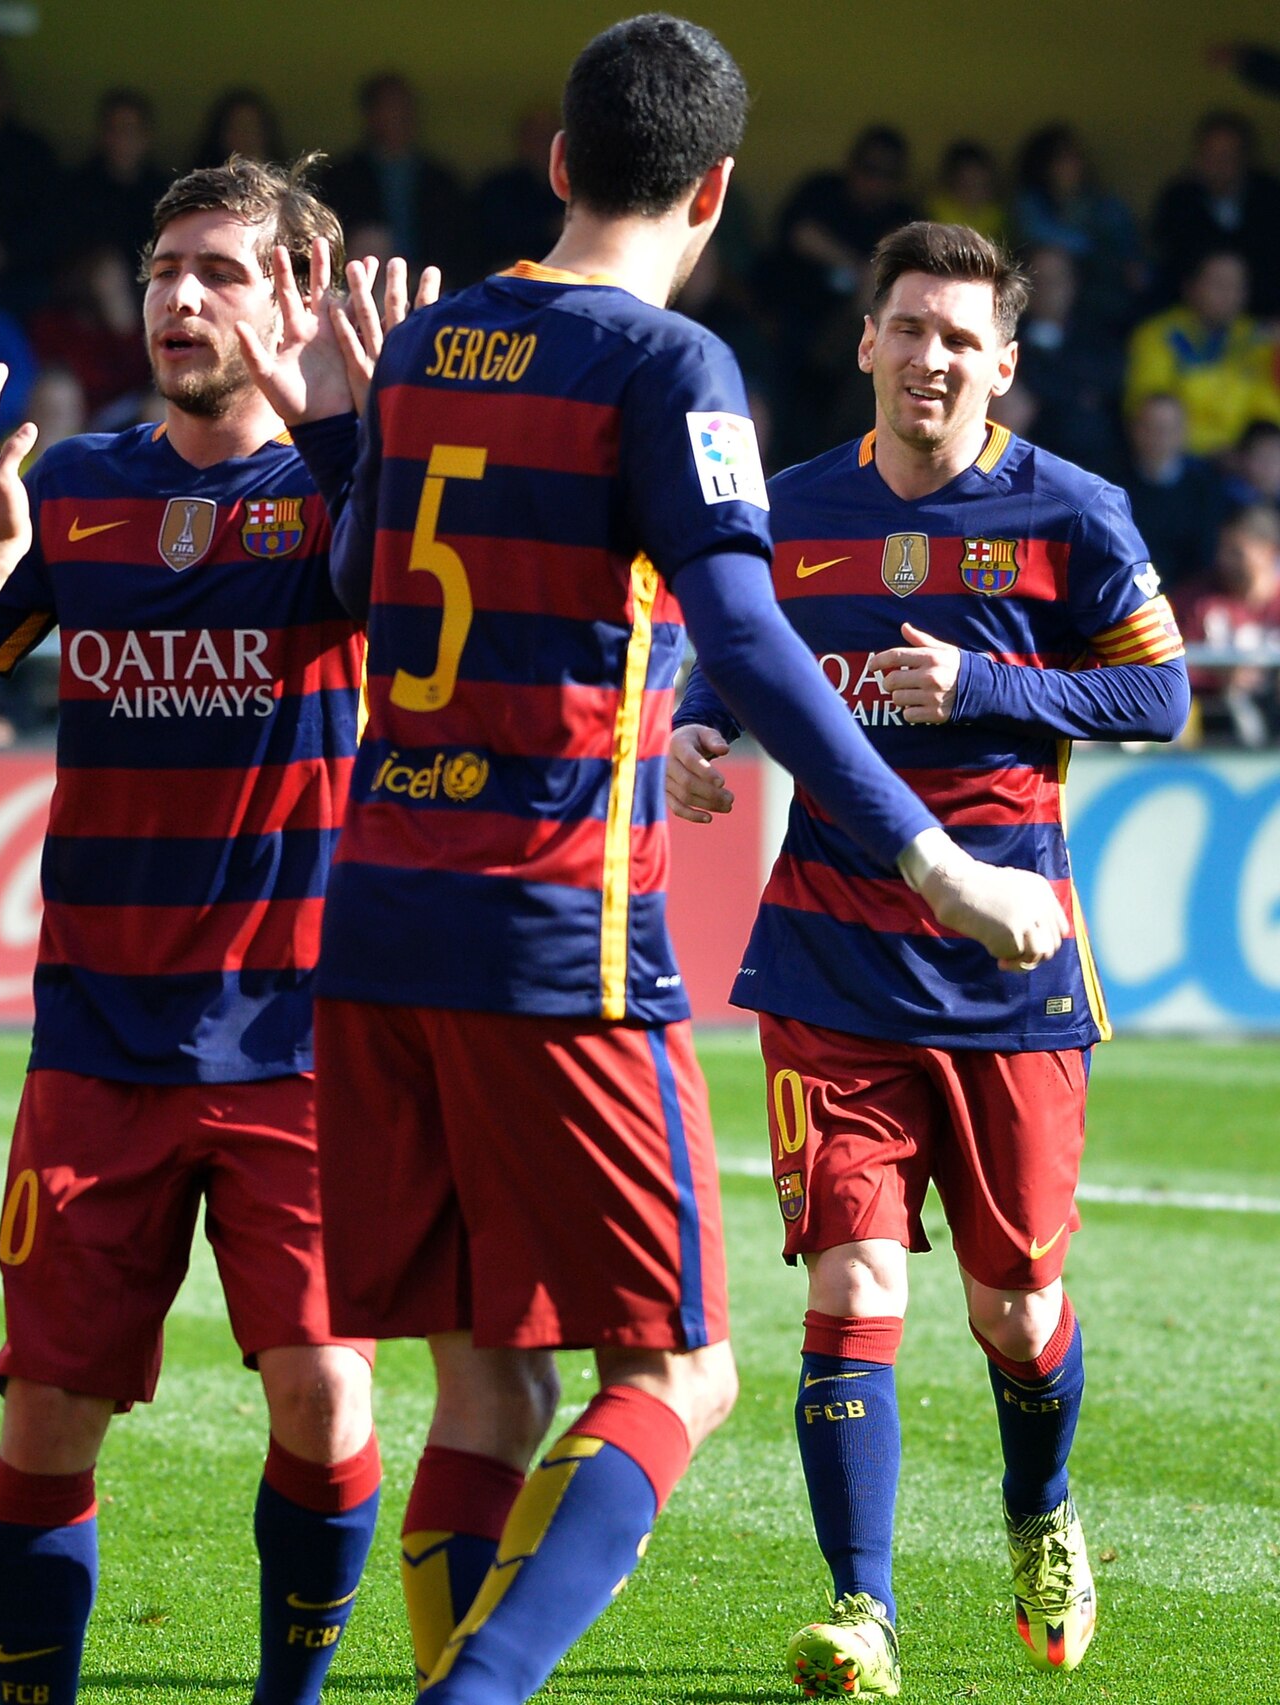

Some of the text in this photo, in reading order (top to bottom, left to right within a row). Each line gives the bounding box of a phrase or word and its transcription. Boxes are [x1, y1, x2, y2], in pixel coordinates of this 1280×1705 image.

[425, 325, 537, 382] SERGIO
[389, 444, 488, 712] 5
[894, 572, 915, 581] FIFA
[977, 562, 1000, 570] FCB
[68, 628, 274, 693] QATAR
[109, 684, 276, 718] AIRWAYS
[804, 1399, 866, 1425] FCB
[1003, 1388, 1060, 1414] FCB
[287, 1624, 341, 1648] FCB
[1, 1681, 50, 1704] FCB
